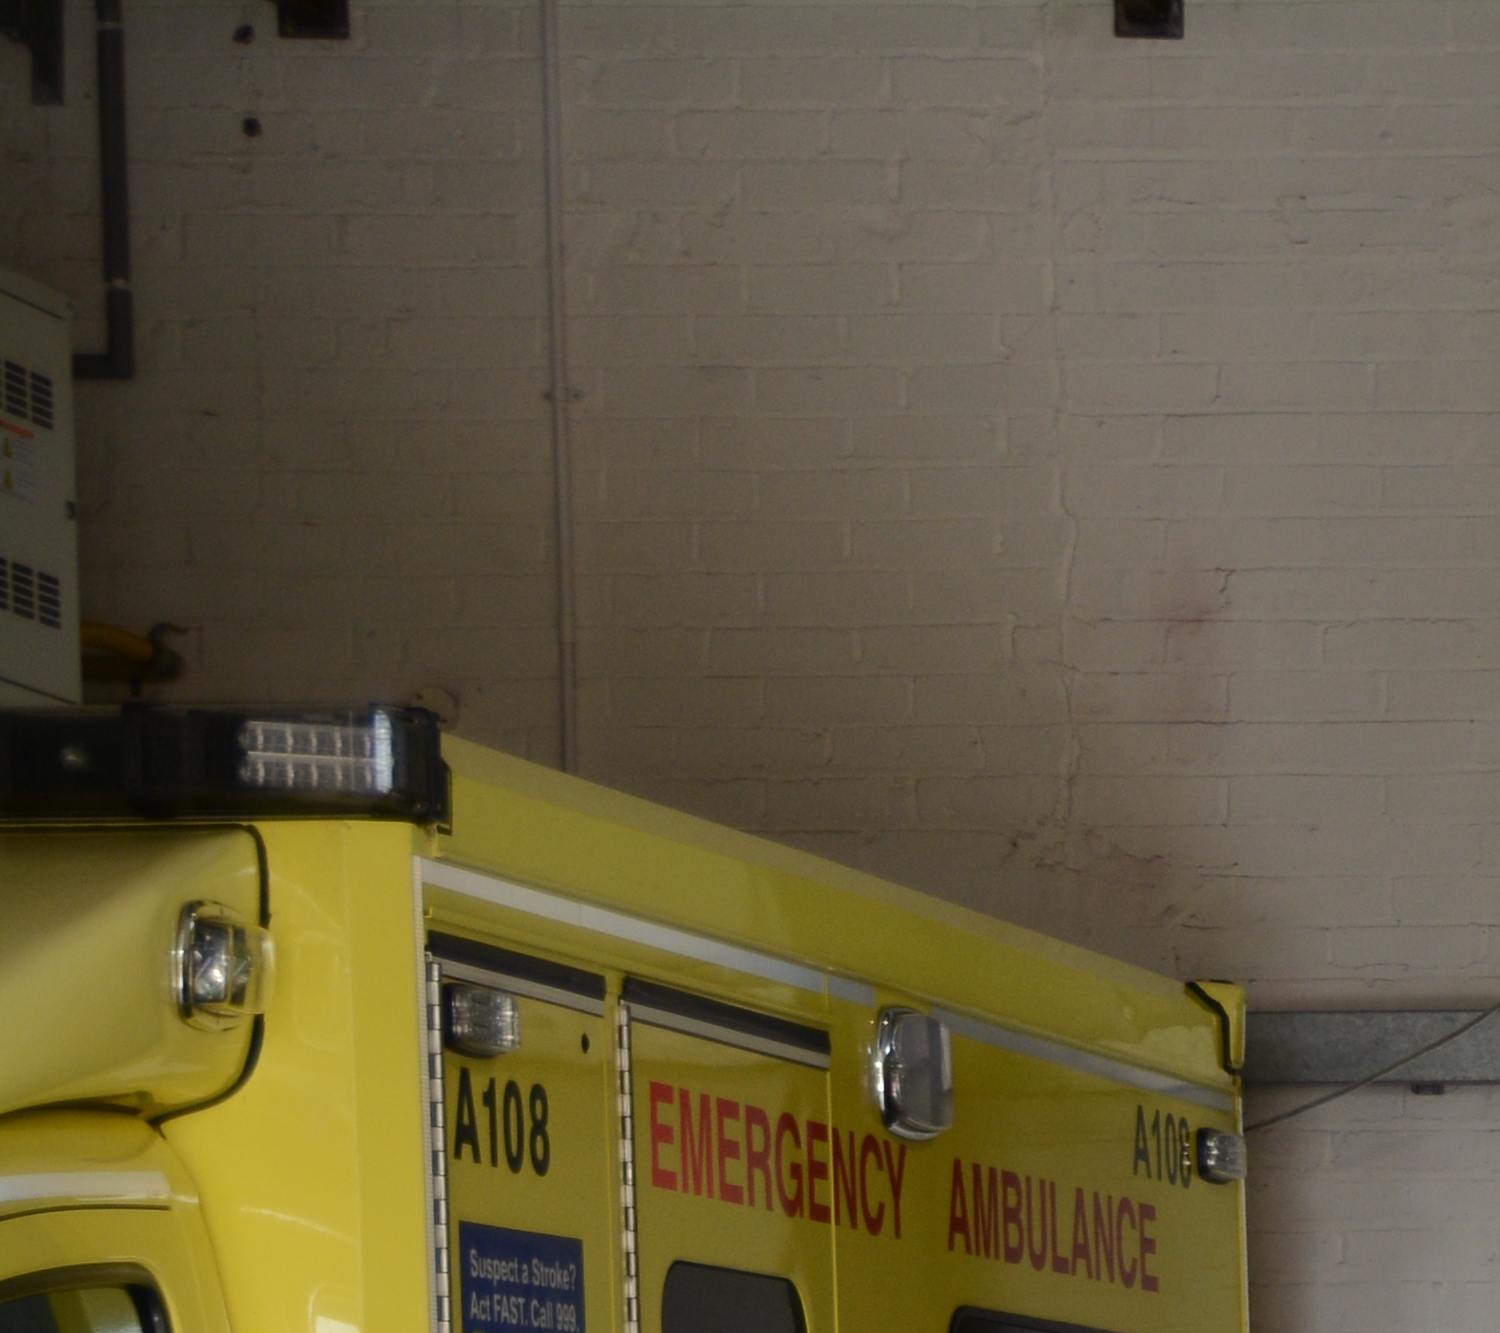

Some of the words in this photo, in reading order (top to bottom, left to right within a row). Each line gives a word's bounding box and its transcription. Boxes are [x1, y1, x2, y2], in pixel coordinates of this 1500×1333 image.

[453, 1066, 550, 1177] A108
[1133, 1104, 1193, 1189] A108
[649, 1080, 908, 1239] EMERGENCY
[948, 1158, 1160, 1293] AMBULANCE
[470, 1248, 519, 1287] Suspect
[521, 1263, 529, 1285] a
[532, 1257, 577, 1291] Stroke?
[470, 1291, 491, 1323] Act
[493, 1293, 529, 1326] FAST.
[531, 1298, 553, 1329] Call
[556, 1303, 580, 1333] 999.
